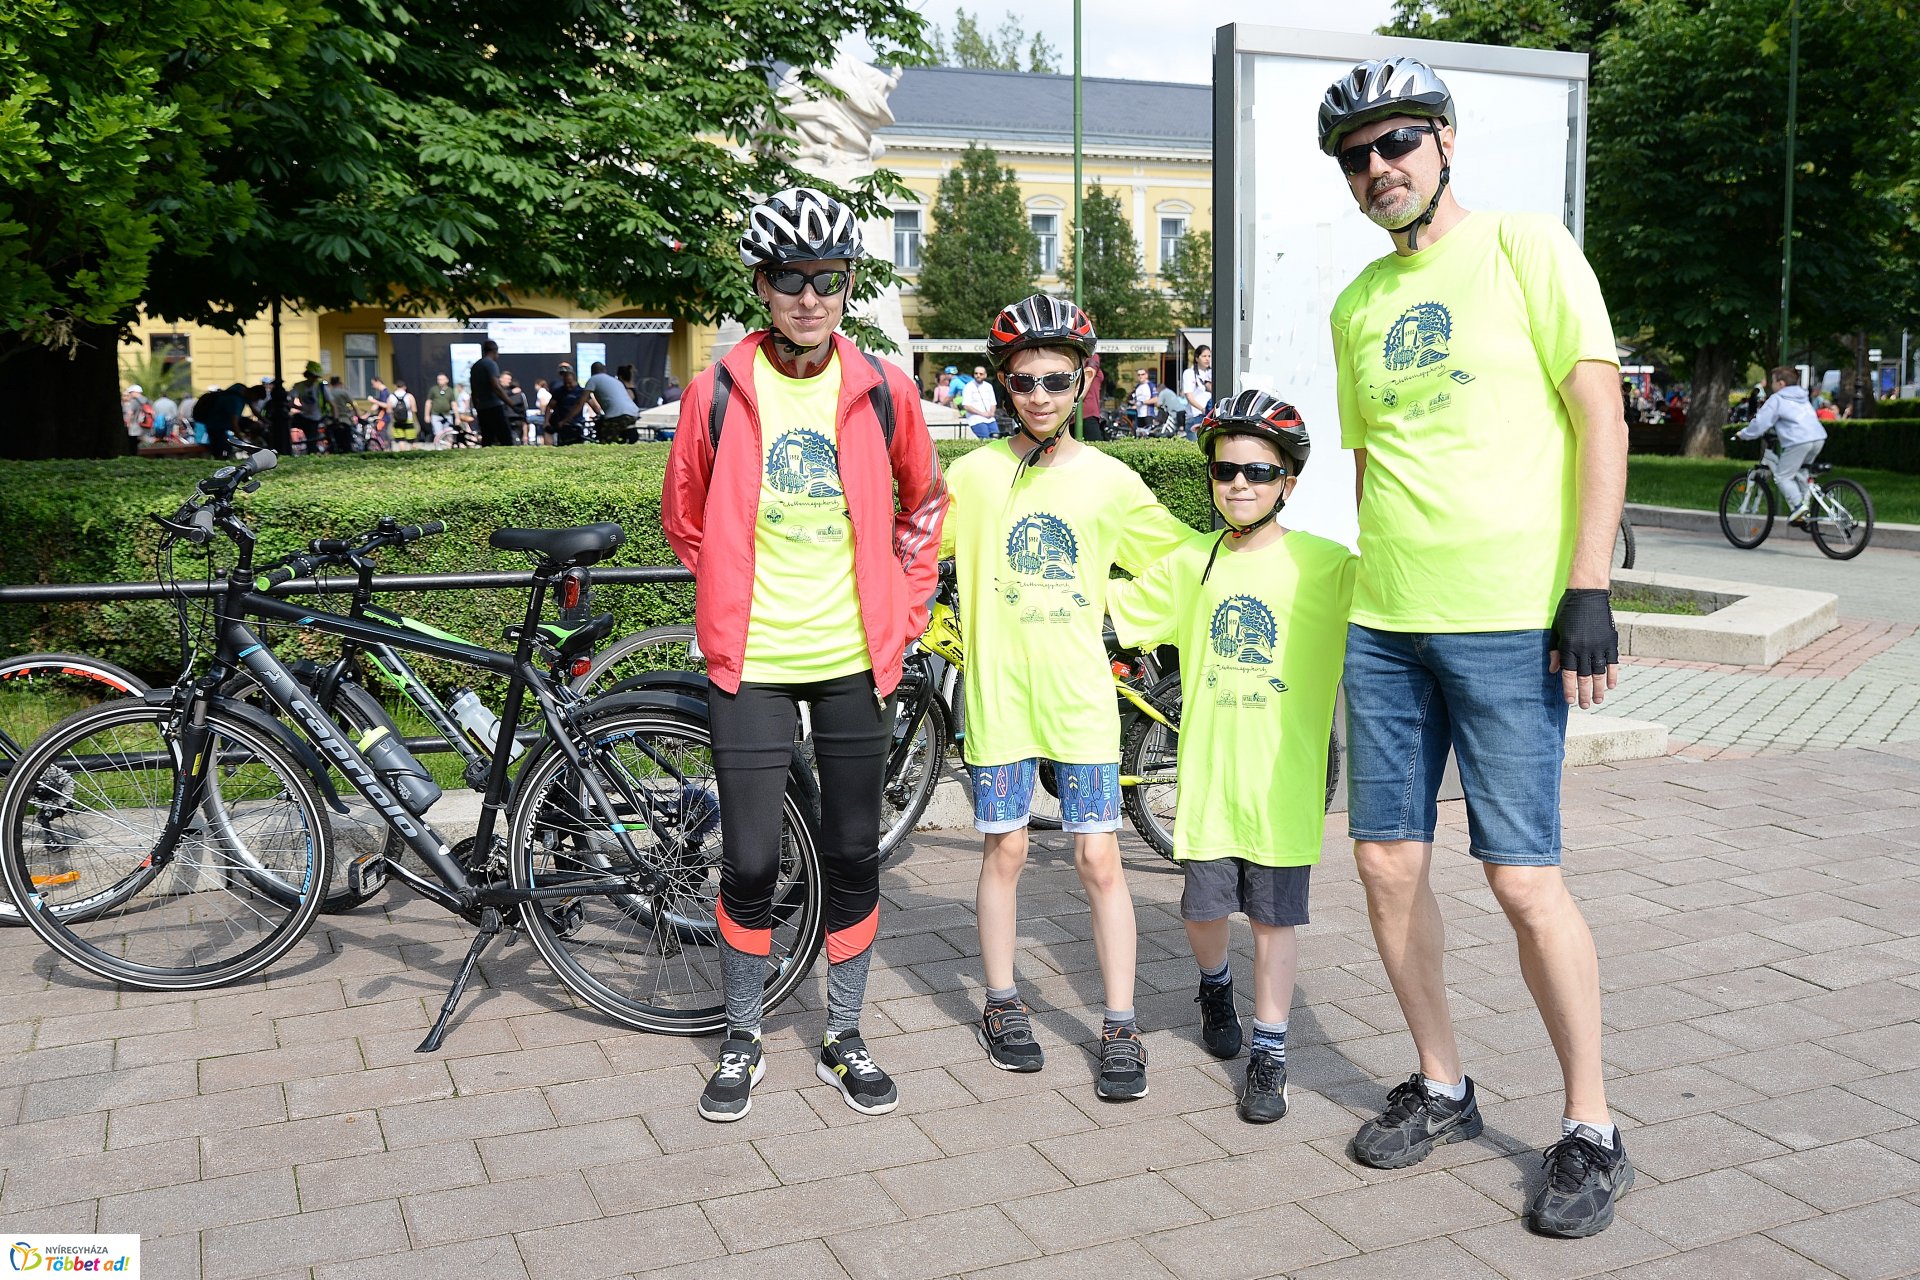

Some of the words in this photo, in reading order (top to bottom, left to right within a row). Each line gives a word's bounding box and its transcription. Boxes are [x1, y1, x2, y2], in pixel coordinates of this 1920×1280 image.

[362, 610, 403, 629] SPARK
[291, 700, 418, 838] capriolo
[1102, 764, 1112, 801] WAVES
[1582, 1128, 1600, 1140] NIKE
